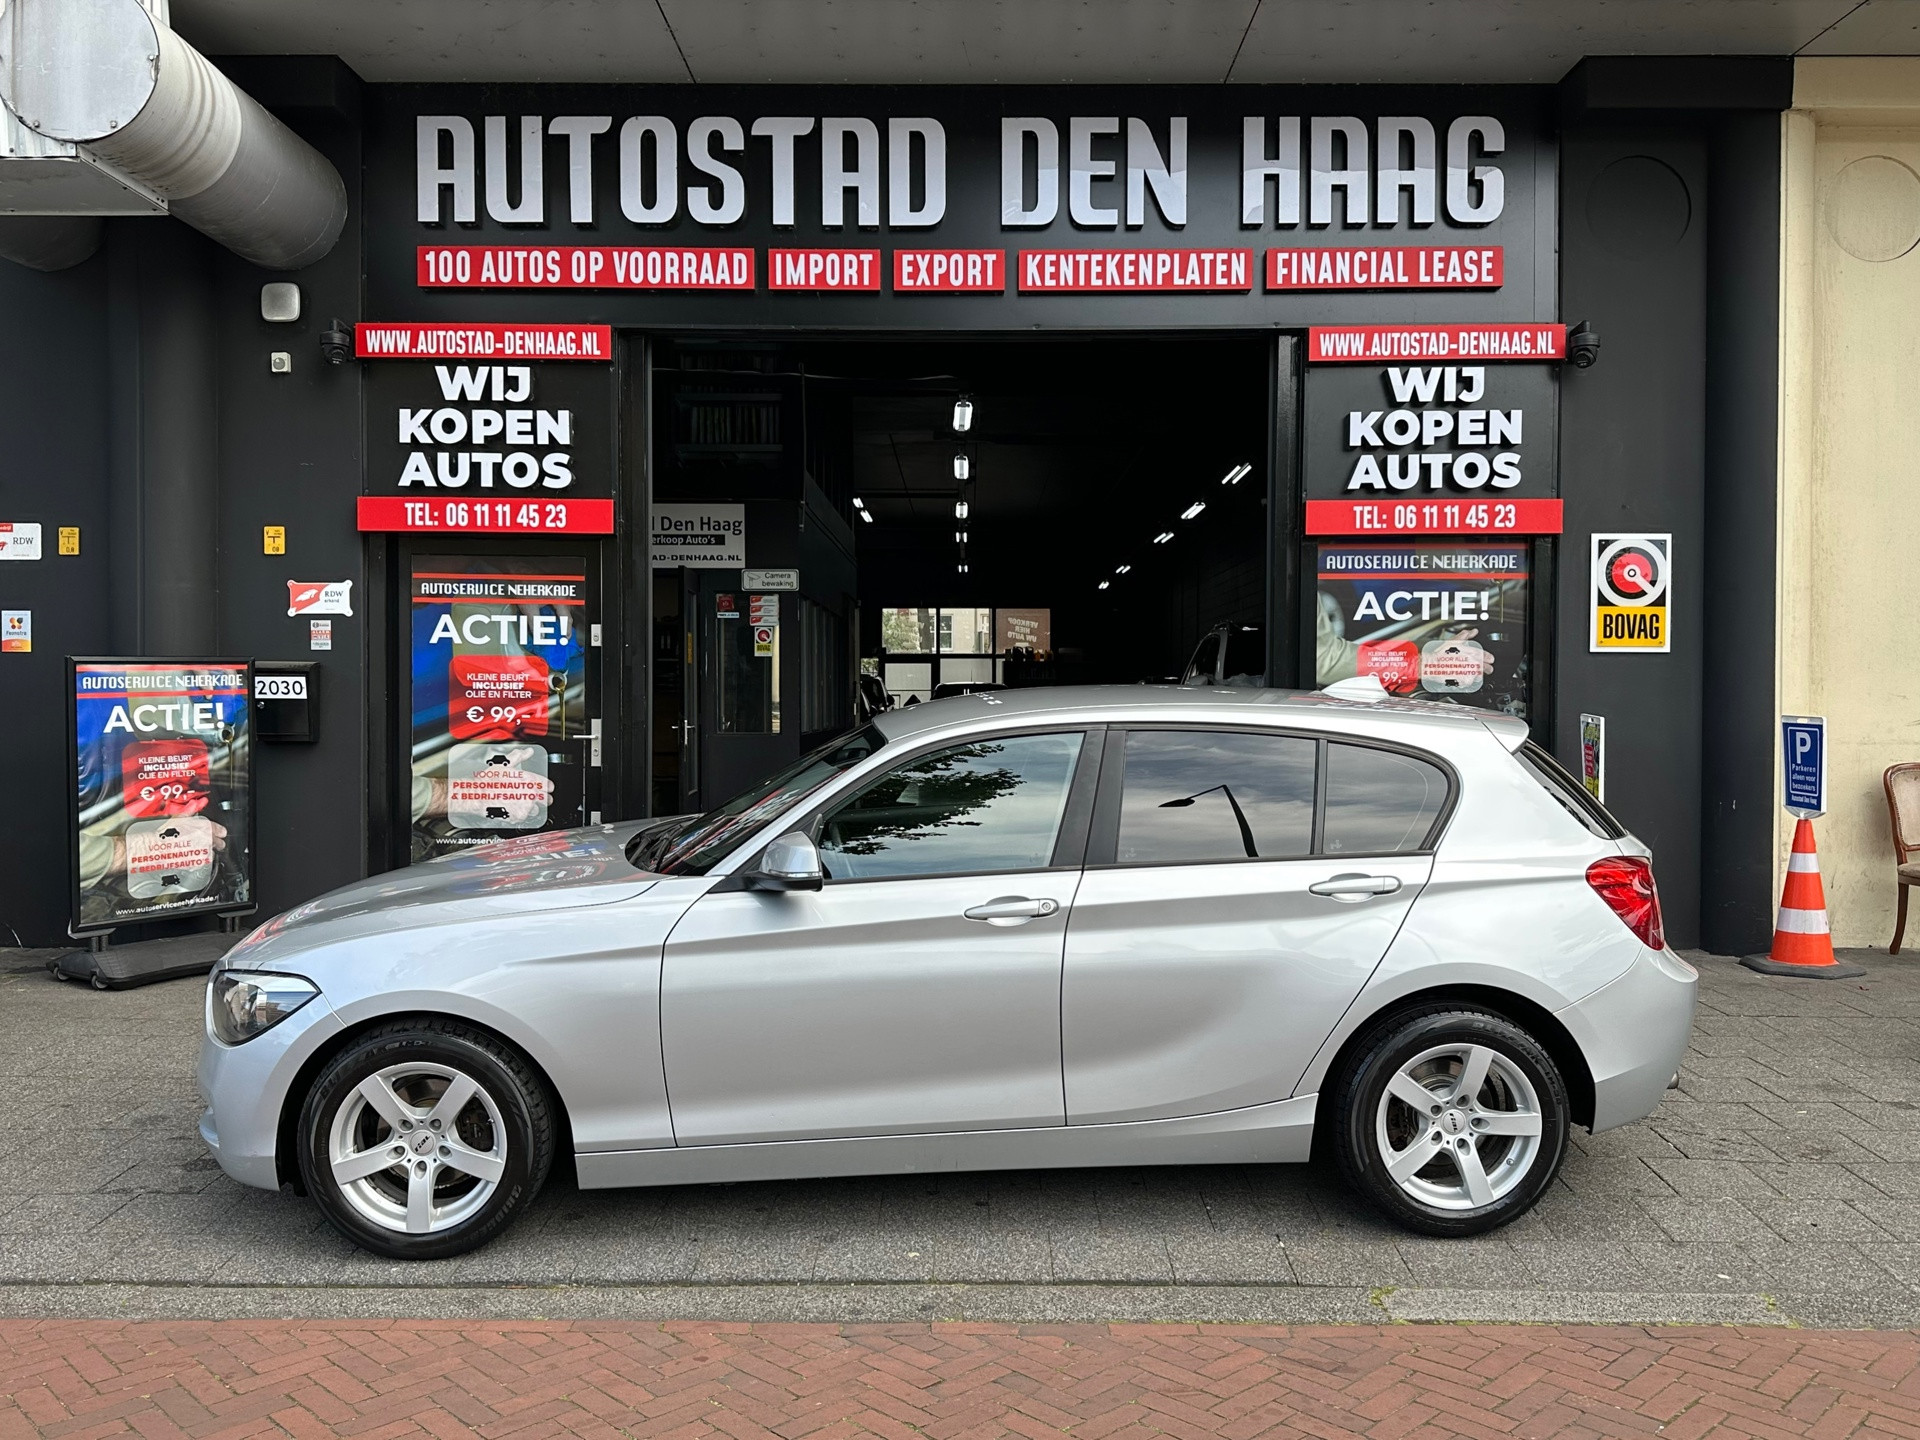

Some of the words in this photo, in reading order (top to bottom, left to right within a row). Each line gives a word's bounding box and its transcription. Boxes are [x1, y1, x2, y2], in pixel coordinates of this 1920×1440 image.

[417, 115, 947, 227] AUTOSTAD
[1001, 116, 1188, 227] DEN
[1241, 115, 1505, 226] HAAG
[425, 250, 471, 284] 100
[480, 250, 561, 284] AUTOS
[571, 251, 604, 285] OP
[613, 251, 748, 286] VOORRAAD
[774, 252, 873, 286] IMPORT
[901, 252, 997, 286] EXPORT
[1025, 251, 1246, 287] KENTEKENPLATEN
[1276, 251, 1409, 286] FINANCIAL
[1417, 250, 1494, 284] LEASE
[365, 329, 601, 355] WWW.AUTOSTAD-DENHAAG.NL
[1319, 331, 1555, 357] WWW.AUTOSTAD-DENHAAG.NL
[434, 366, 531, 402] WIJ
[1386, 366, 1486, 402] WIJ
[398, 407, 571, 445] KOPEN
[1348, 409, 1523, 447] KOPEN
[397, 452, 573, 488] AUTOS
[1347, 452, 1522, 490] AUTOS
[404, 502, 439, 526] TEL:
[445, 503, 469, 526] 06
[473, 503, 490, 527] 11
[494, 503, 511, 527] 11
[516, 503, 540, 527] 45
[545, 503, 567, 528] 23
[1353, 505, 1388, 529] TEL:
[1393, 505, 1417, 529] 06
[1422, 504, 1438, 528] 11
[1443, 504, 1460, 528] 11
[1465, 504, 1489, 528] 45
[1494, 504, 1516, 528] 23
[660, 516, 695, 532] Den
[700, 516, 743, 536] Haag
[12, 536, 34, 545] RDW
[685, 535, 716, 545] Auto's
[1326, 554, 1429, 570] AUTOSERVICE
[1432, 554, 1518, 569] NEHERKADE
[421, 582, 505, 596] AUTOSERVICE
[508, 584, 577, 597] NEHERKADE
[761, 579, 794, 588] bewaking
[324, 590, 344, 598] RDW
[1353, 590, 1490, 621] ACTIE!
[429, 613, 569, 646] ACTIE!
[1603, 613, 1660, 640] BOVAG
[83, 675, 172, 690] AUTOSERVICE
[175, 673, 244, 688] NEHERKADE
[466, 673, 498, 681] KLEINE
[500, 673, 530, 682] BEURT
[472, 682, 525, 690] INCLUSIEF
[257, 680, 304, 696] 2030
[465, 690, 486, 698] OLIE
[488, 690, 501, 699] EN
[502, 690, 532, 699] FILTER
[103, 702, 225, 733] ACTIE!
[466, 706, 485, 723] €
[490, 706, 531, 726] 99,-
[1795, 731, 1812, 764] P
[138, 756, 166, 764] KLEINE
[167, 754, 193, 763] BEURT
[143, 762, 189, 771] INCLUSIEF
[1791, 763, 1816, 773] Parkeren
[138, 771, 156, 780] OLIE
[157, 770, 170, 779] EN
[171, 769, 196, 778] FILTER
[473, 770, 500, 779] VOOR
[501, 770, 524, 779] ALLE
[140, 786, 155, 802] €
[160, 784, 195, 802] 99,-
[452, 781, 543, 790] PERSONENAUTO'S
[451, 792, 459, 801] &
[461, 792, 545, 802] BEDRIJFSAUTO'S
[148, 842, 173, 852] VOOR
[174, 840, 192, 849] ALLE
[131, 849, 209, 864] PERSONENAUTO'S
[138, 859, 211, 874] BEDRIJFSAUTO'S
